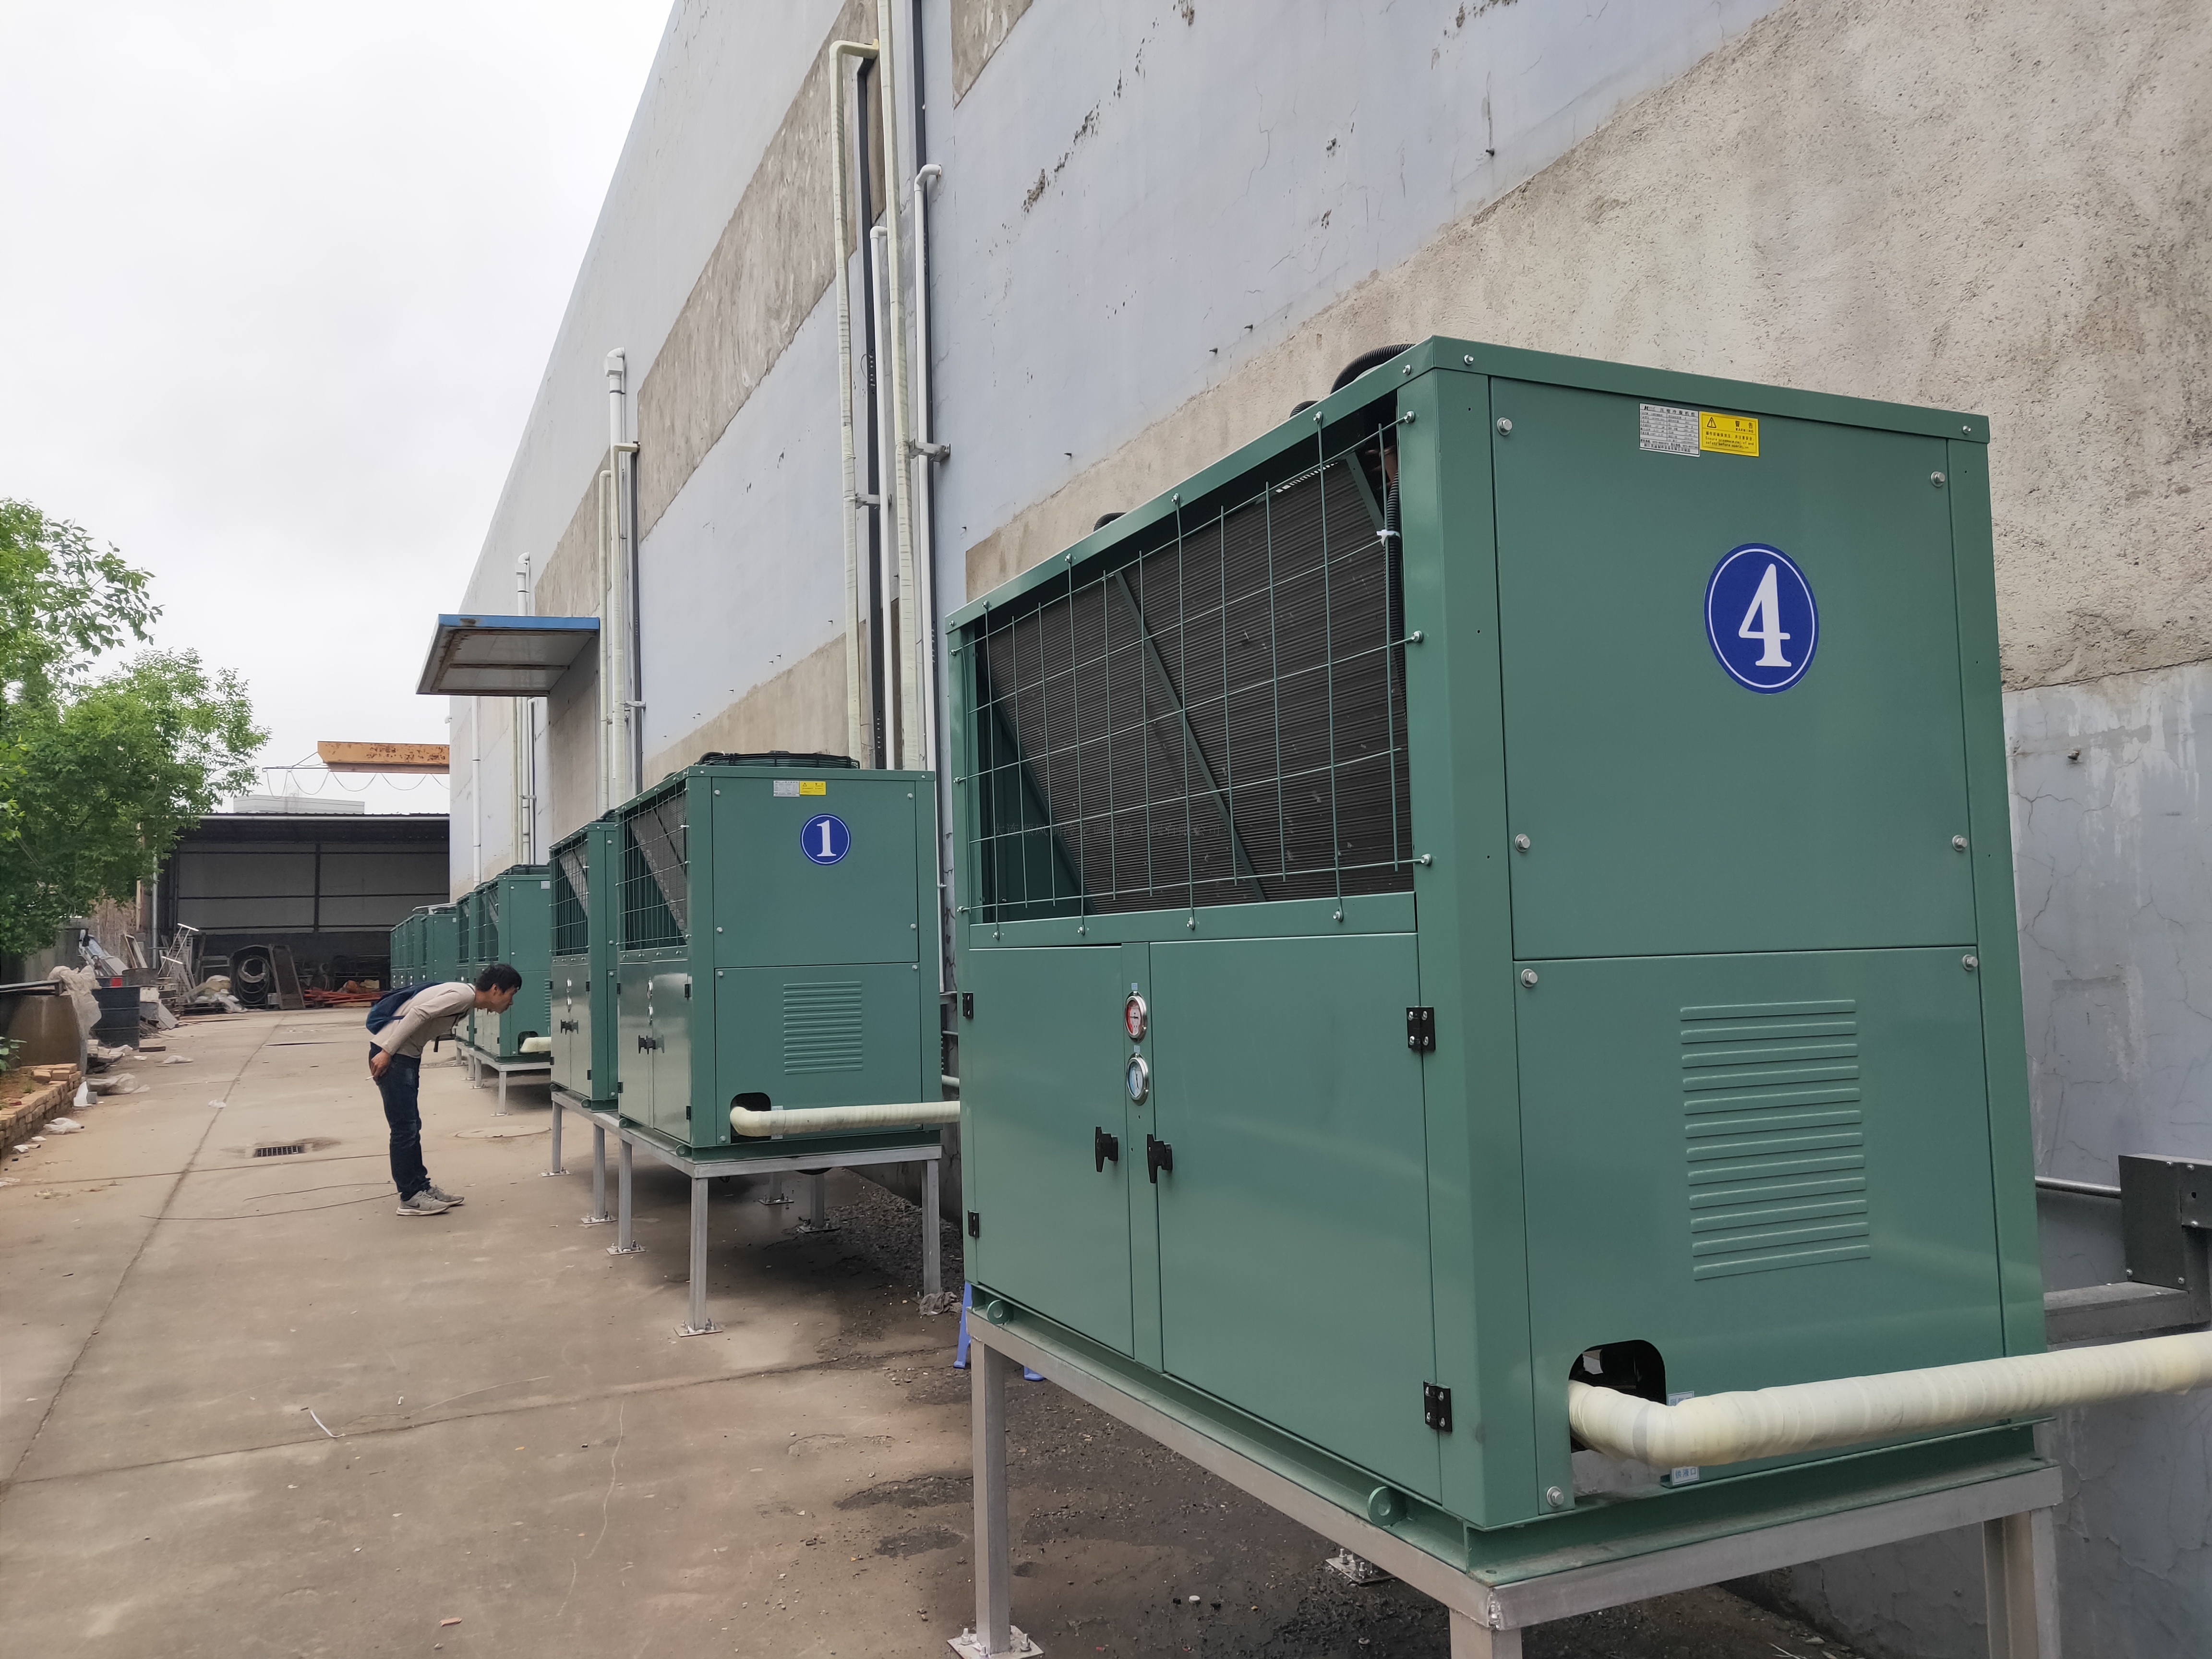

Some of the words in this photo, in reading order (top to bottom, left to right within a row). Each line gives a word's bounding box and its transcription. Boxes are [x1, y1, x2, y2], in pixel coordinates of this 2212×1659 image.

[1735, 421, 1753, 429] 警告
[1739, 564, 1791, 667] 4
[817, 819, 837, 857] 1
[1676, 1467, 1696, 1479] 供液口
